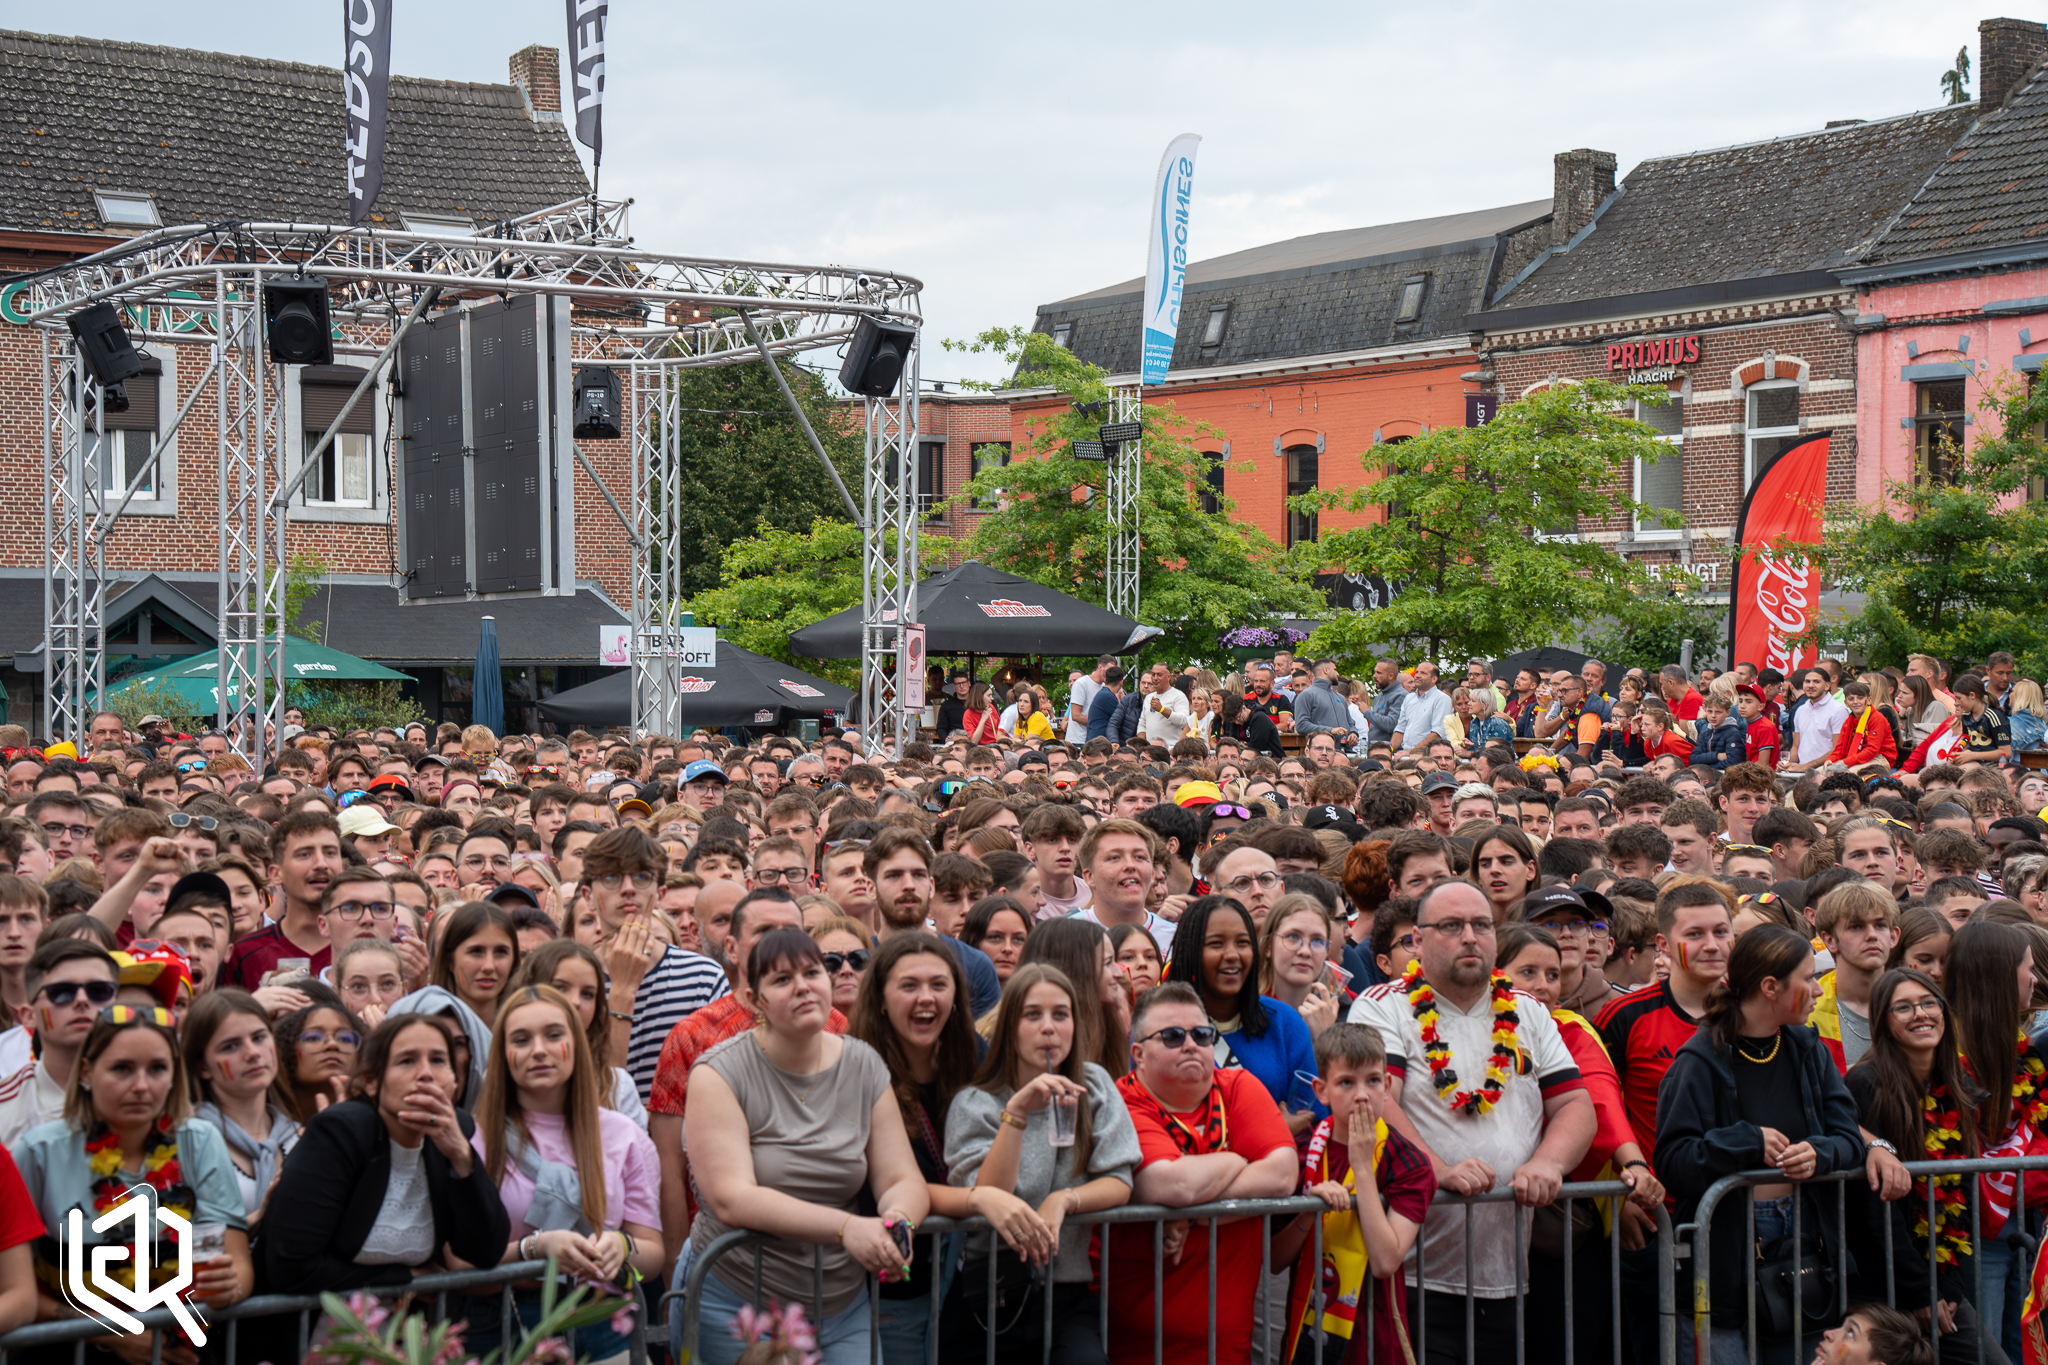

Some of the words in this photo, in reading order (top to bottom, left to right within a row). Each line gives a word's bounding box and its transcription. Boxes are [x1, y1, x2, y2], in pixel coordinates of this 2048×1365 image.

[1607, 336, 1699, 371] PRIMUS
[1628, 370, 1675, 384] HAACHT
[1757, 540, 1810, 676] ca-Cola
